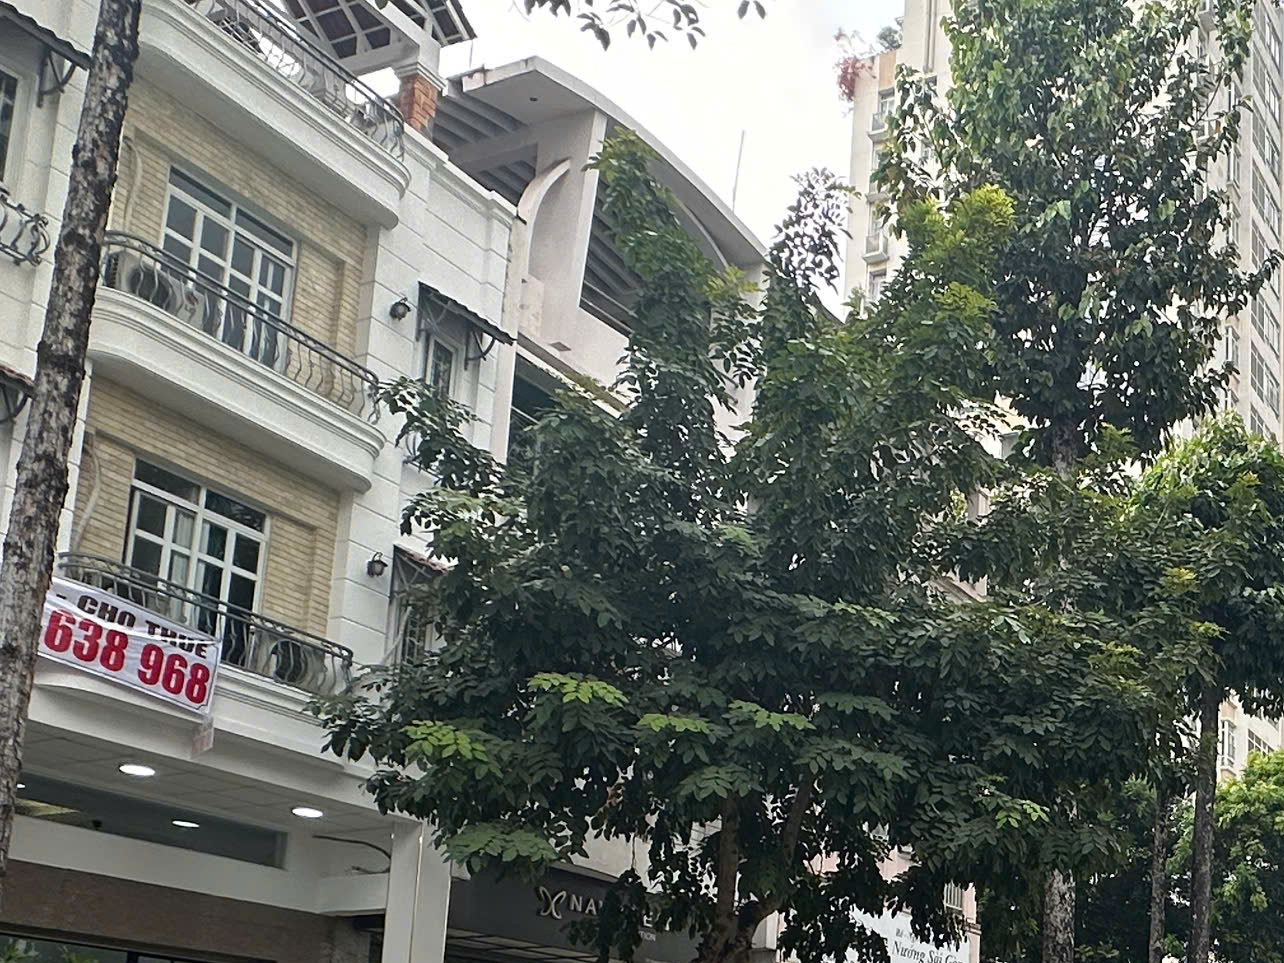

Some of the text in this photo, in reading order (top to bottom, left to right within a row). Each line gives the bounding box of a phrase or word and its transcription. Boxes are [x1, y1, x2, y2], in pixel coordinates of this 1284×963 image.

[77, 594, 136, 628] CHO
[43, 608, 211, 704] 638 968
